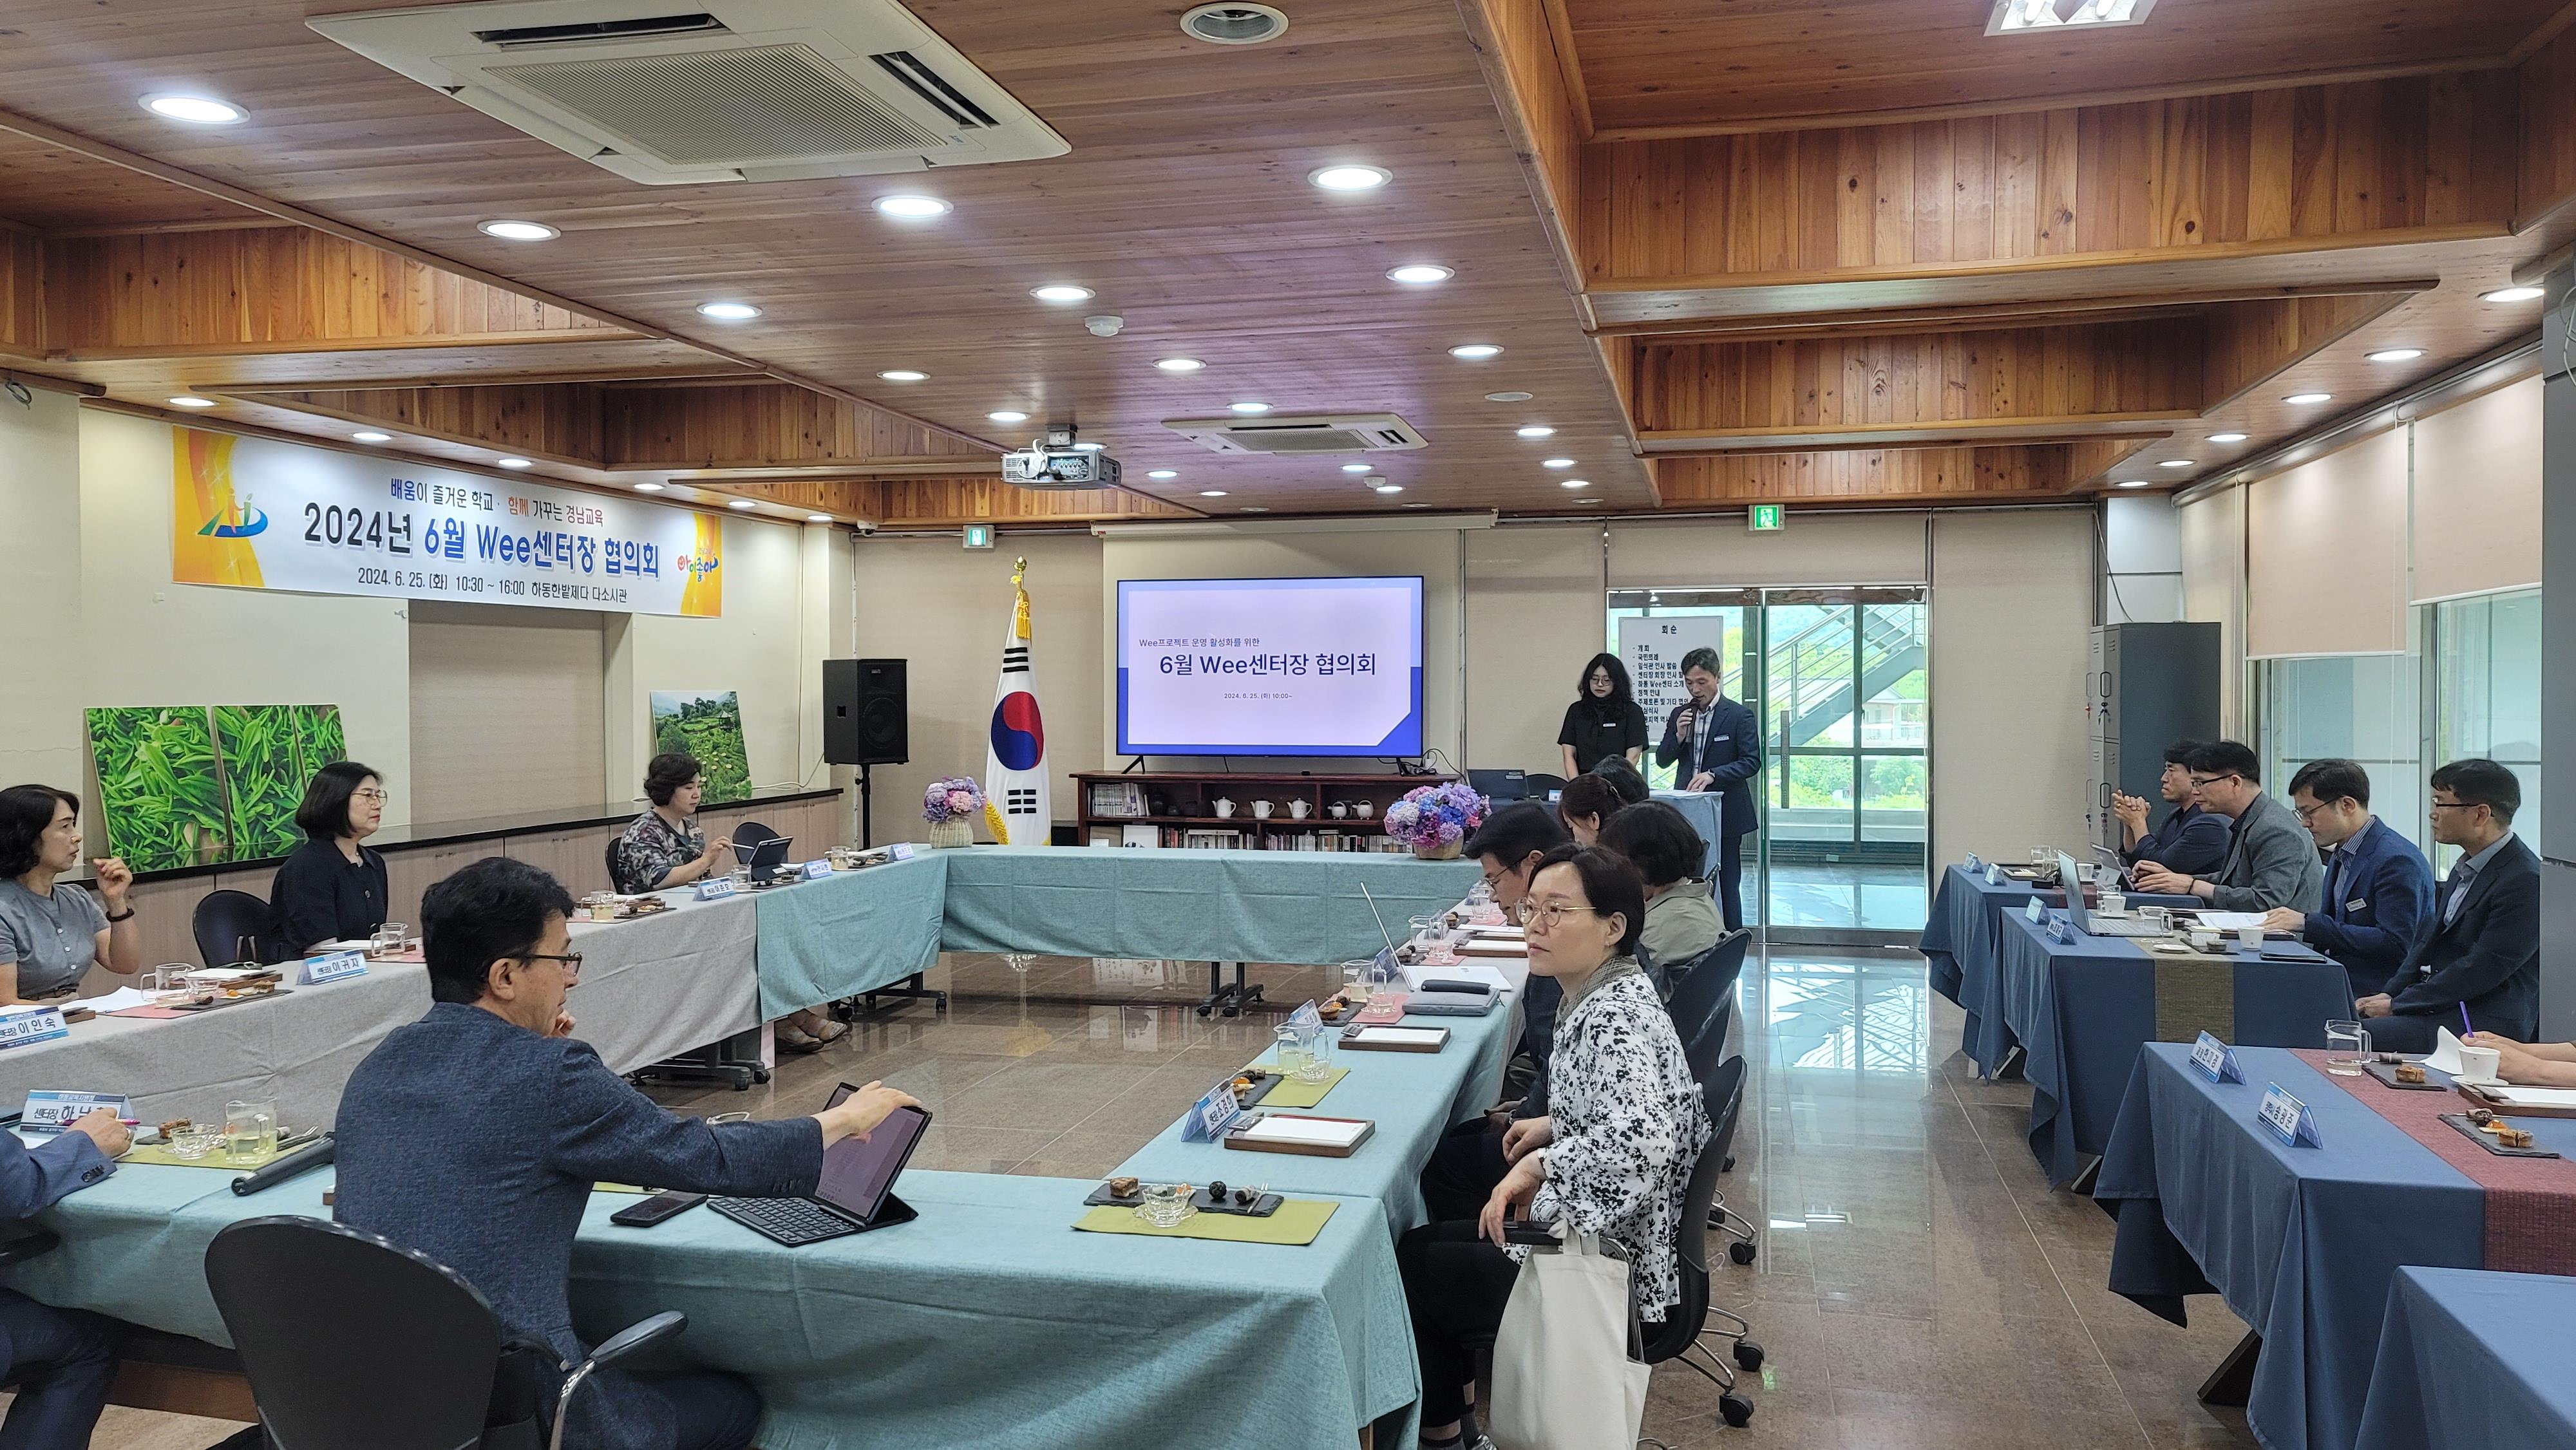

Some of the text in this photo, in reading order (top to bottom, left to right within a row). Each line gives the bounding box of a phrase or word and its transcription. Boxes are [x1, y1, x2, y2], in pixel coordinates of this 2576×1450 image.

[390, 478, 428, 503] 배움이
[432, 485, 467, 507] 즐거운
[471, 491, 494, 511] 학교
[507, 496, 529, 517] 함께
[533, 500, 563, 522] 가꾸는
[566, 505, 603, 527] 경남교육
[304, 502, 659, 579] 2024년 6월 Wee센터장 협의회
[357, 567, 391, 585] 2024.
[395, 570, 404, 586] 6.
[409, 572, 425, 587] 25.
[456, 576, 484, 592] 10:30
[498, 579, 525, 596] 16:00
[1139, 638, 1260, 648] Wee프로젝트 운영 활성화를 위한
[1160, 653, 1376, 675] 6월 Wee센터장 협의회
[18, 1017, 56, 1033] 이인숙
[33, 1107, 59, 1120] 센터장
